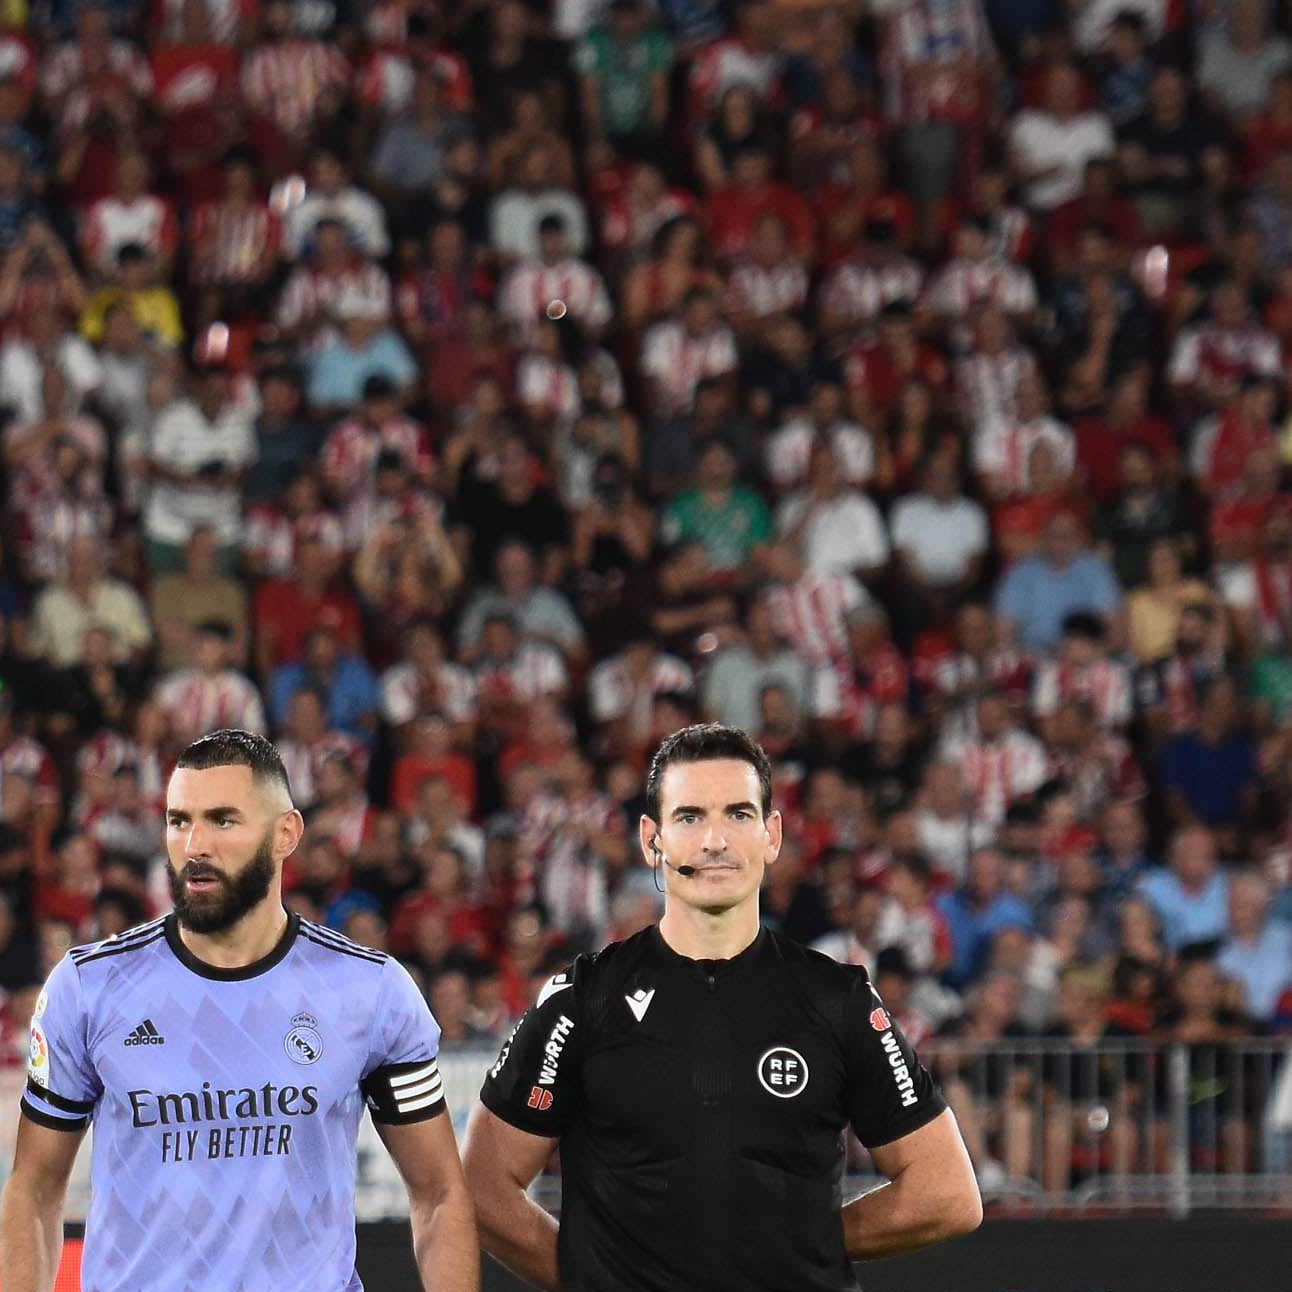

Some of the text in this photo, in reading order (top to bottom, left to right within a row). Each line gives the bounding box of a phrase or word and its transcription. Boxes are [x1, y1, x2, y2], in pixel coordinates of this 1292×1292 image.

[124, 1035, 165, 1046] adidas
[127, 1081, 318, 1128] Emirates
[162, 1124, 292, 1163] FLY BETTER
